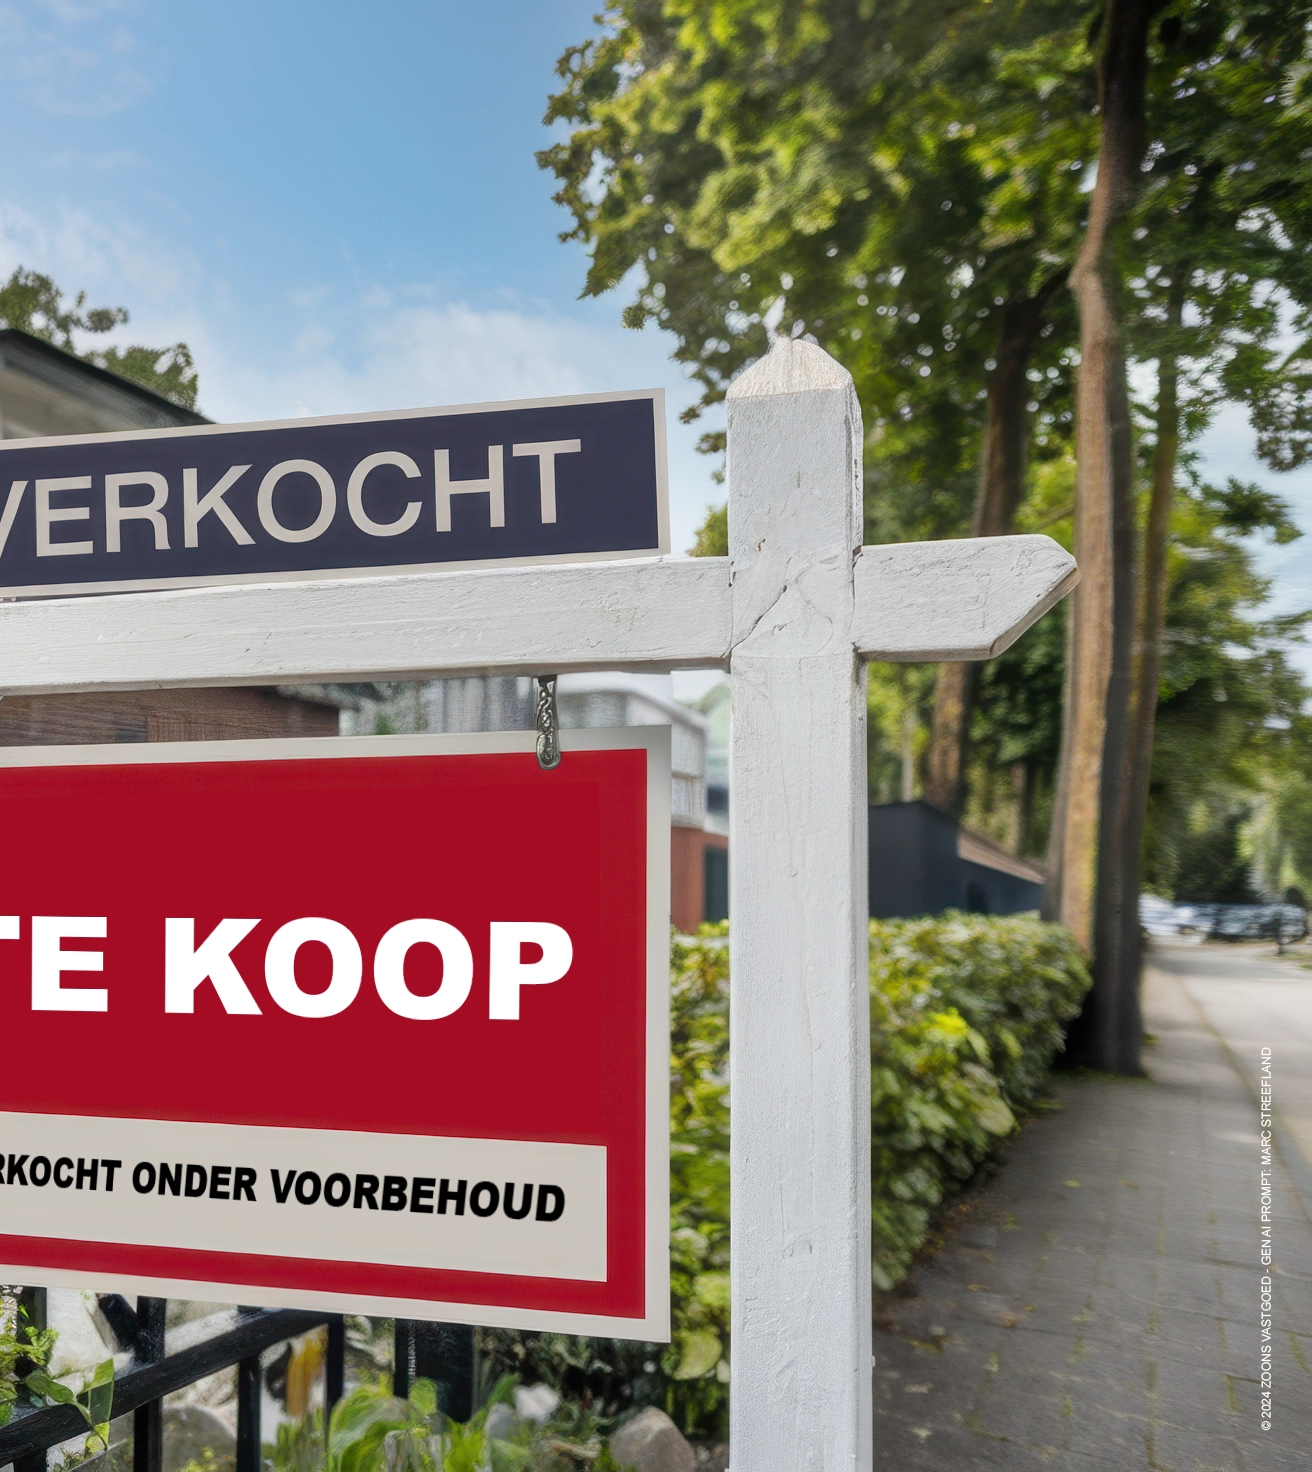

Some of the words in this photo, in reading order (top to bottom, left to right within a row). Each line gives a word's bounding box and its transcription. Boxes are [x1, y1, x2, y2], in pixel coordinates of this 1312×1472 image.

[164, 916, 574, 1021] KOOP
[132, 1161, 258, 1202] ONDER
[270, 1168, 566, 1223] VOORBEHOUD
